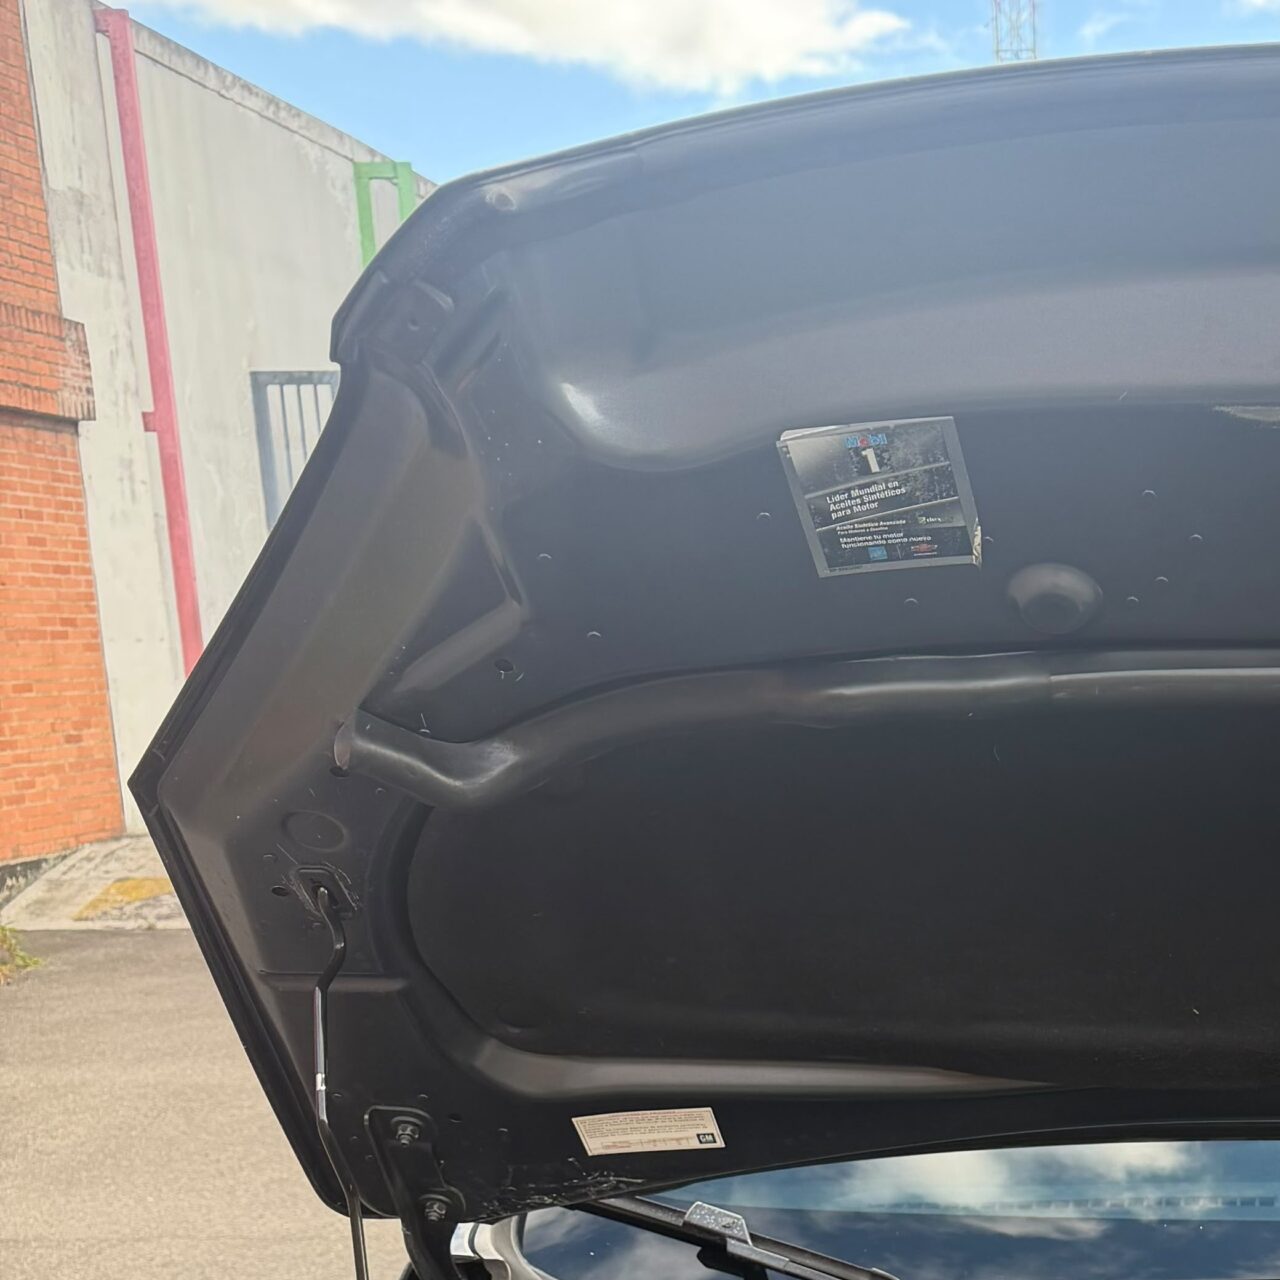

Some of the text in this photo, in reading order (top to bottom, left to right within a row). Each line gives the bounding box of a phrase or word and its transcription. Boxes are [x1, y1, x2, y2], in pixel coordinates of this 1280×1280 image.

[845, 434, 887, 447] Mobil
[861, 448, 880, 473] 1
[851, 484, 887, 496] Mundial
[830, 488, 906, 511] Aceites Sintéticos
[831, 502, 878, 519] para Motor
[700, 1134, 714, 1142] GM
